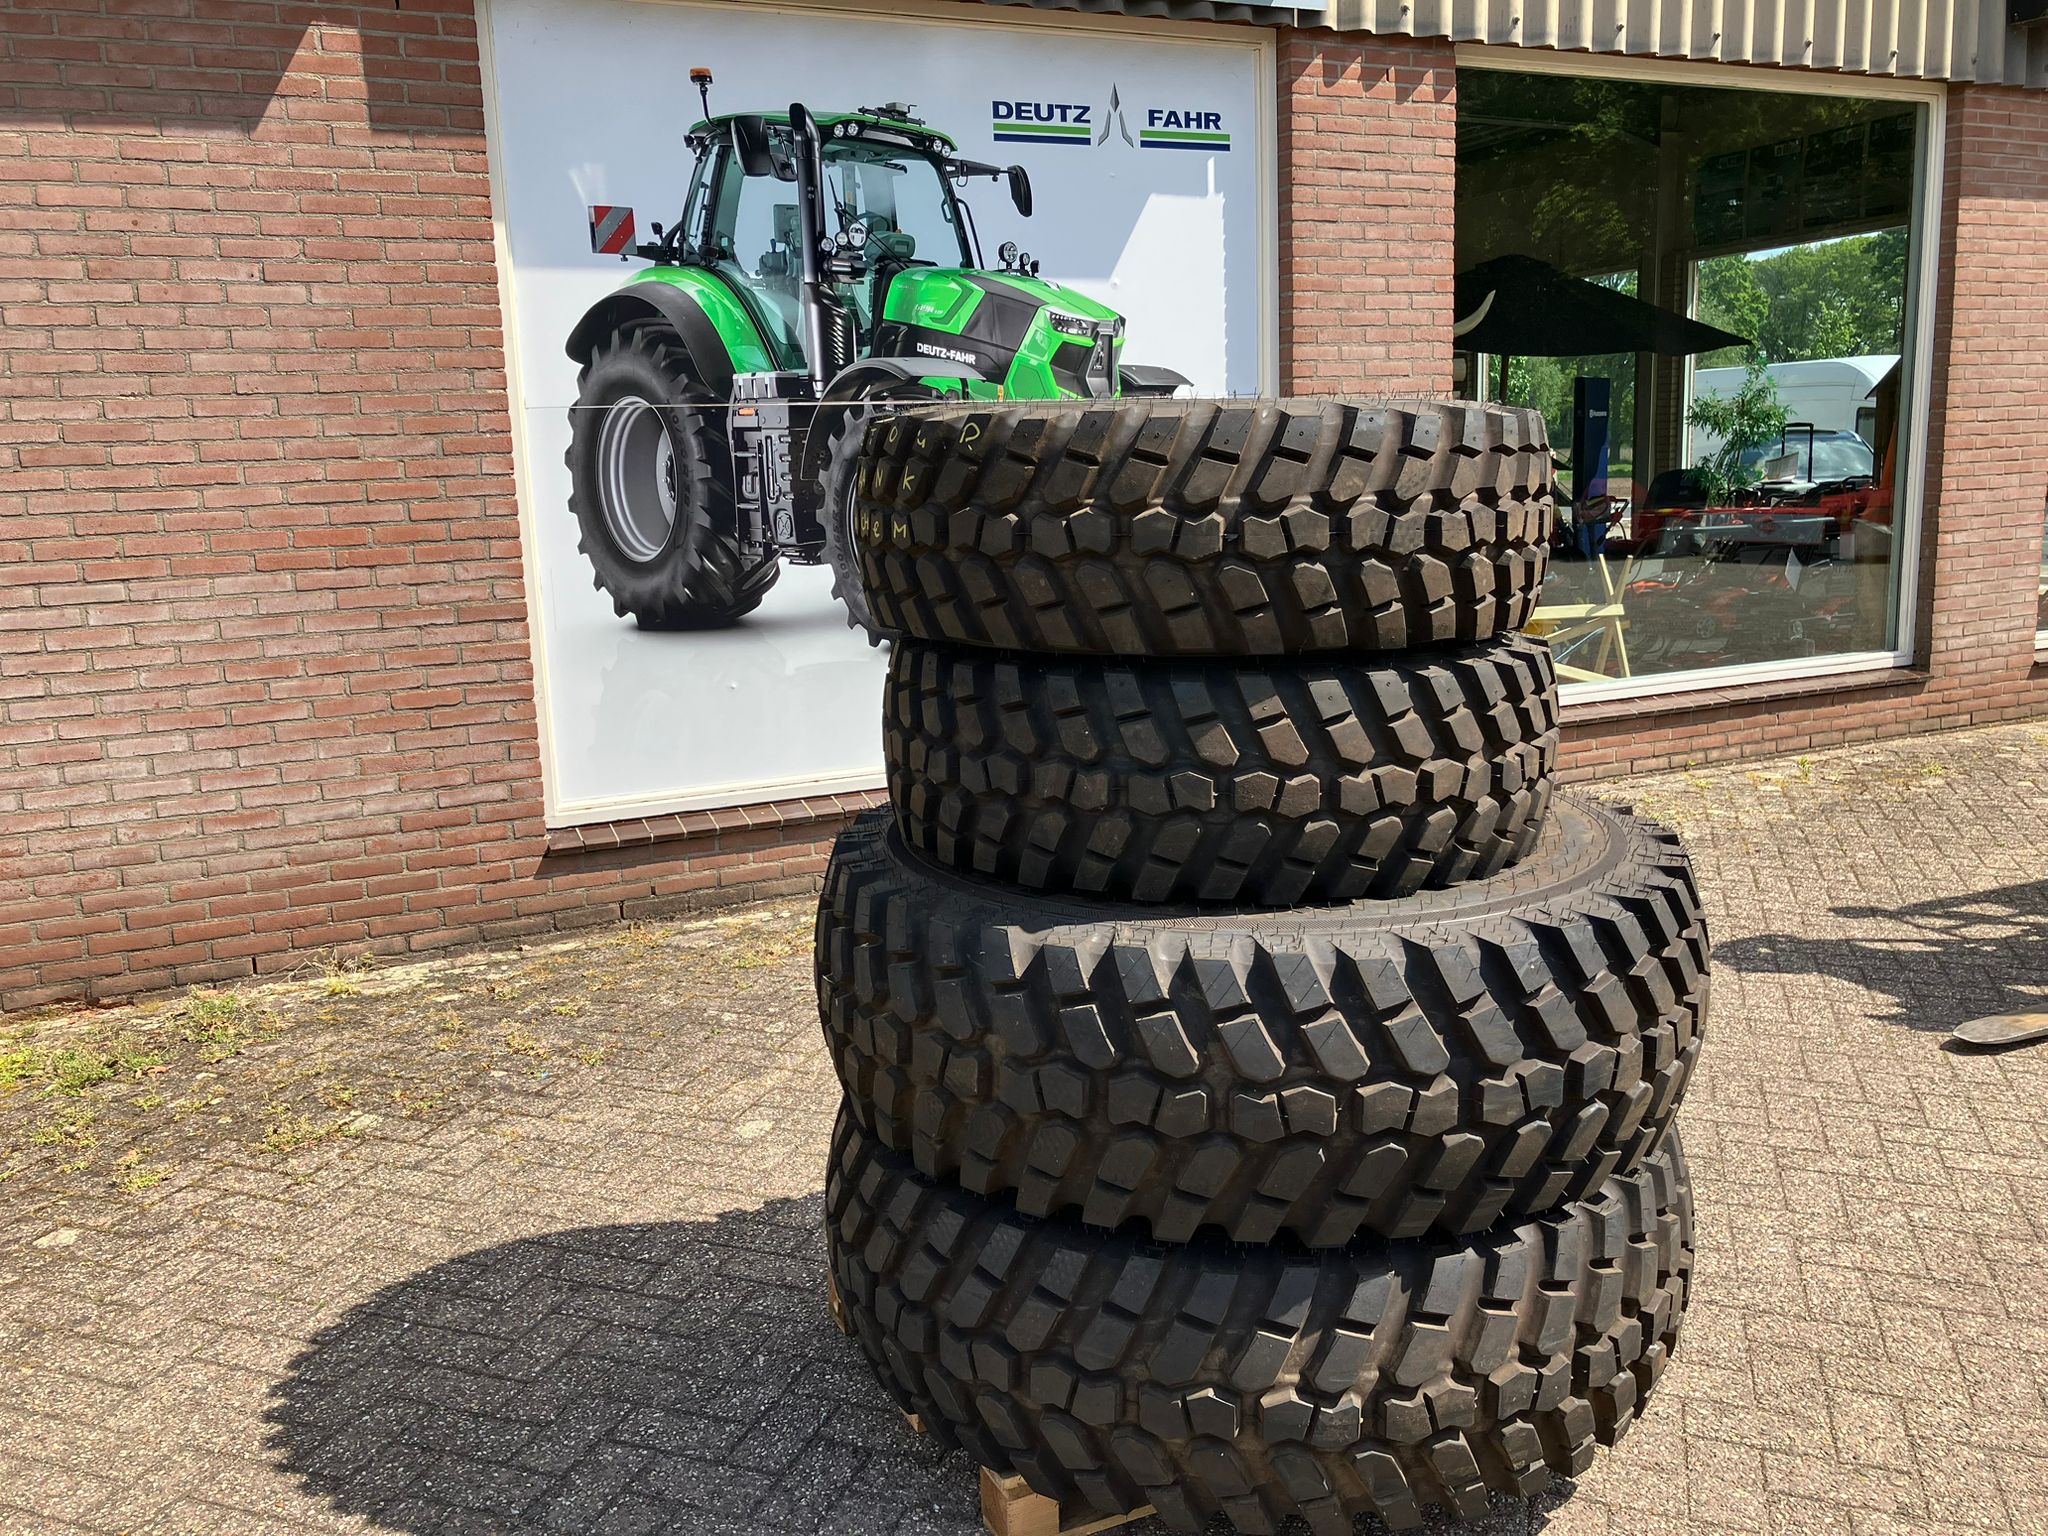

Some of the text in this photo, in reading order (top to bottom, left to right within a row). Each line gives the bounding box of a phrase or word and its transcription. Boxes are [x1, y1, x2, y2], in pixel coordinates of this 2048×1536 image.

[992, 100, 1222, 130] DEUTZ FAHR
[916, 342, 976, 365] DEUTZ-FAHR
